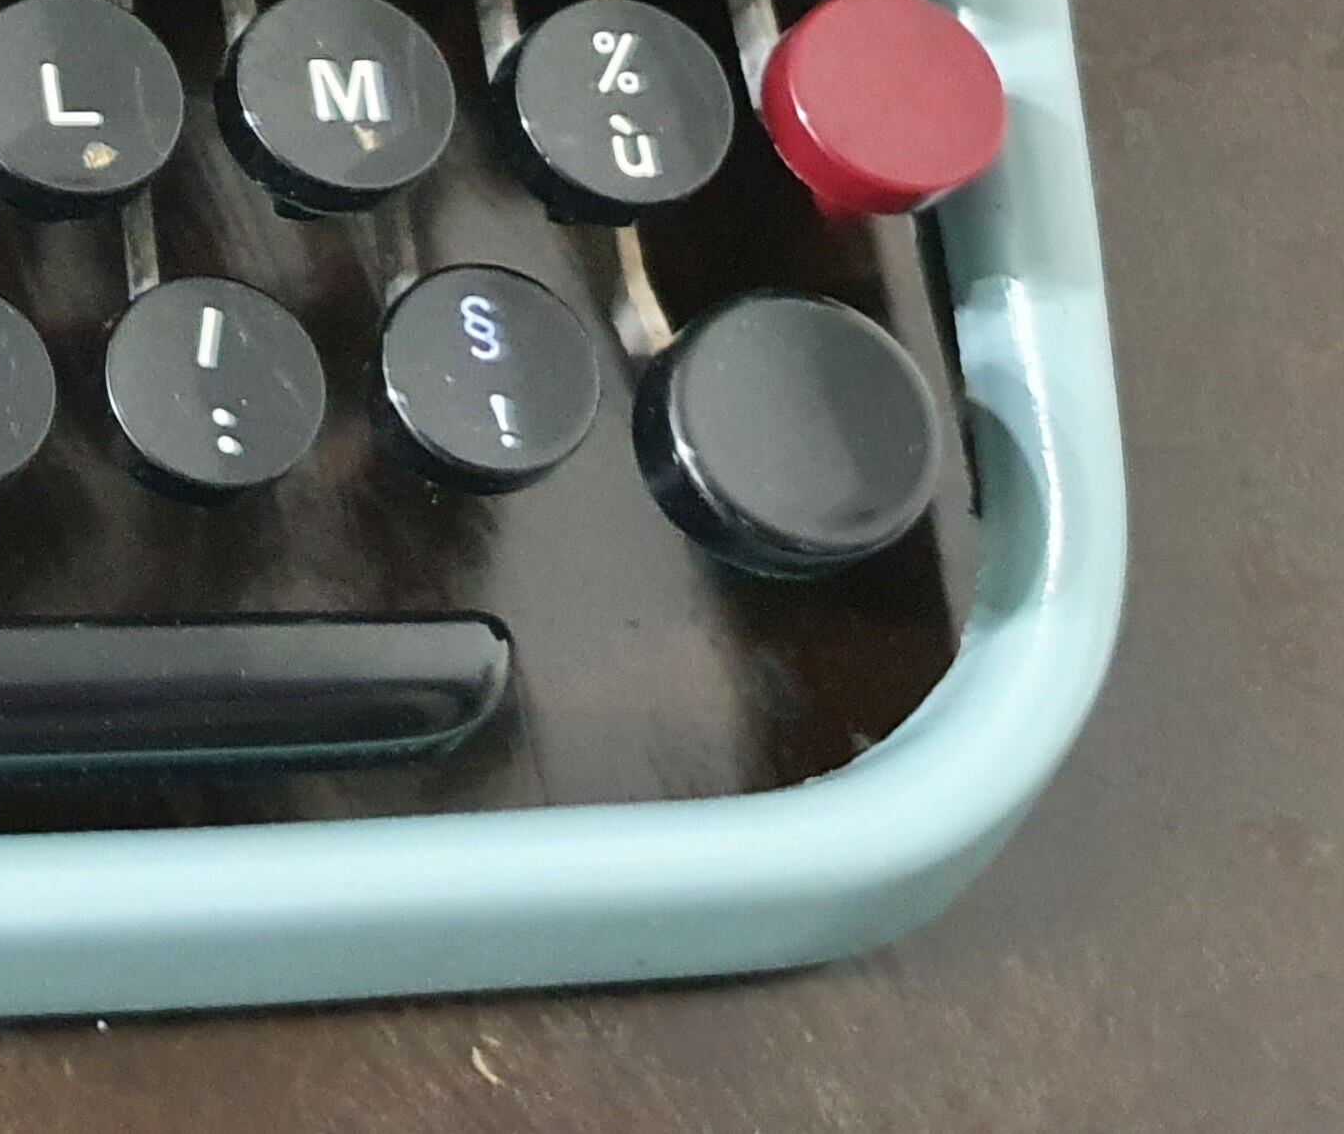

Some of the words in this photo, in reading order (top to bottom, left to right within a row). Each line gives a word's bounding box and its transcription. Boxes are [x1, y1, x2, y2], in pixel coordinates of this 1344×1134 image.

[40, 62, 104, 127] L
[308, 59, 387, 123] M
[592, 31, 640, 94] %
[609, 114, 658, 178] ù
[460, 295, 501, 361] §
[489, 393, 517, 448] !
